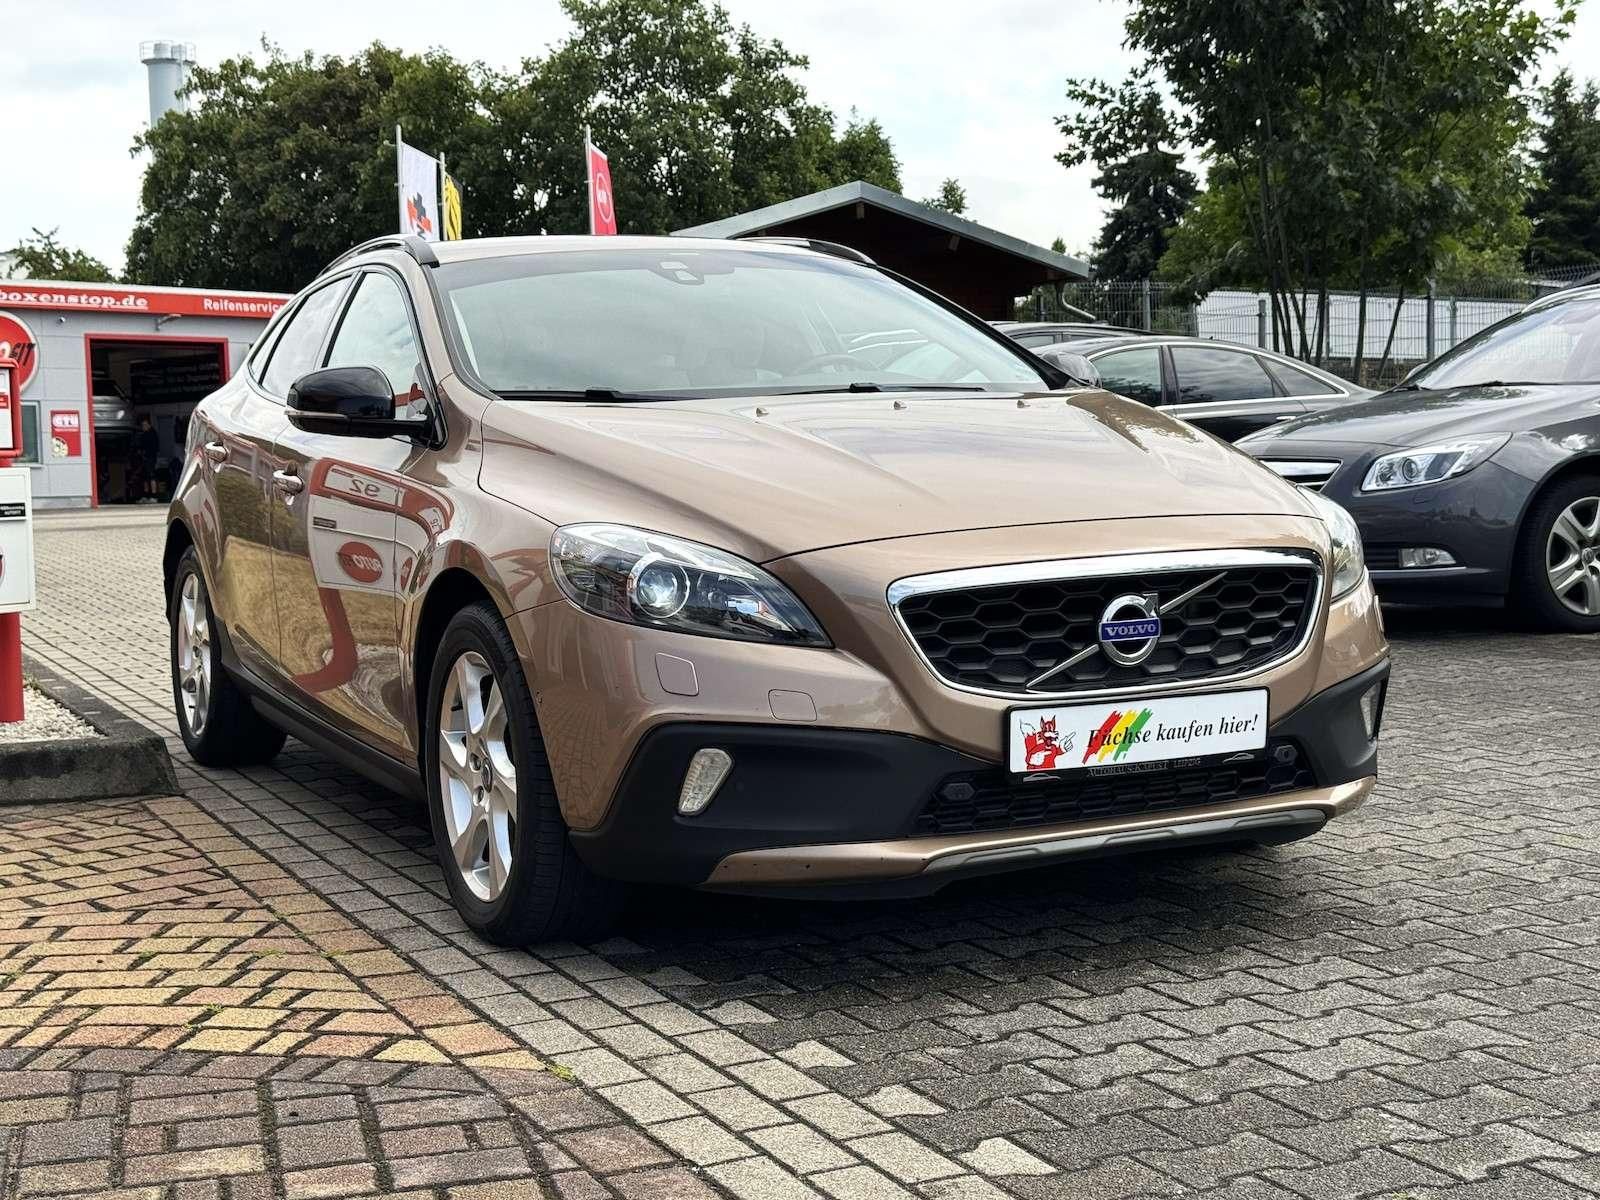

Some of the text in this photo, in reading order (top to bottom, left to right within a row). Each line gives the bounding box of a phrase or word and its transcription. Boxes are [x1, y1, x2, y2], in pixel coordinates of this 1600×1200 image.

[1104, 623, 1157, 637] VOLVO
[1156, 719, 1213, 743] kaufen
[1218, 713, 1258, 736] hier!
